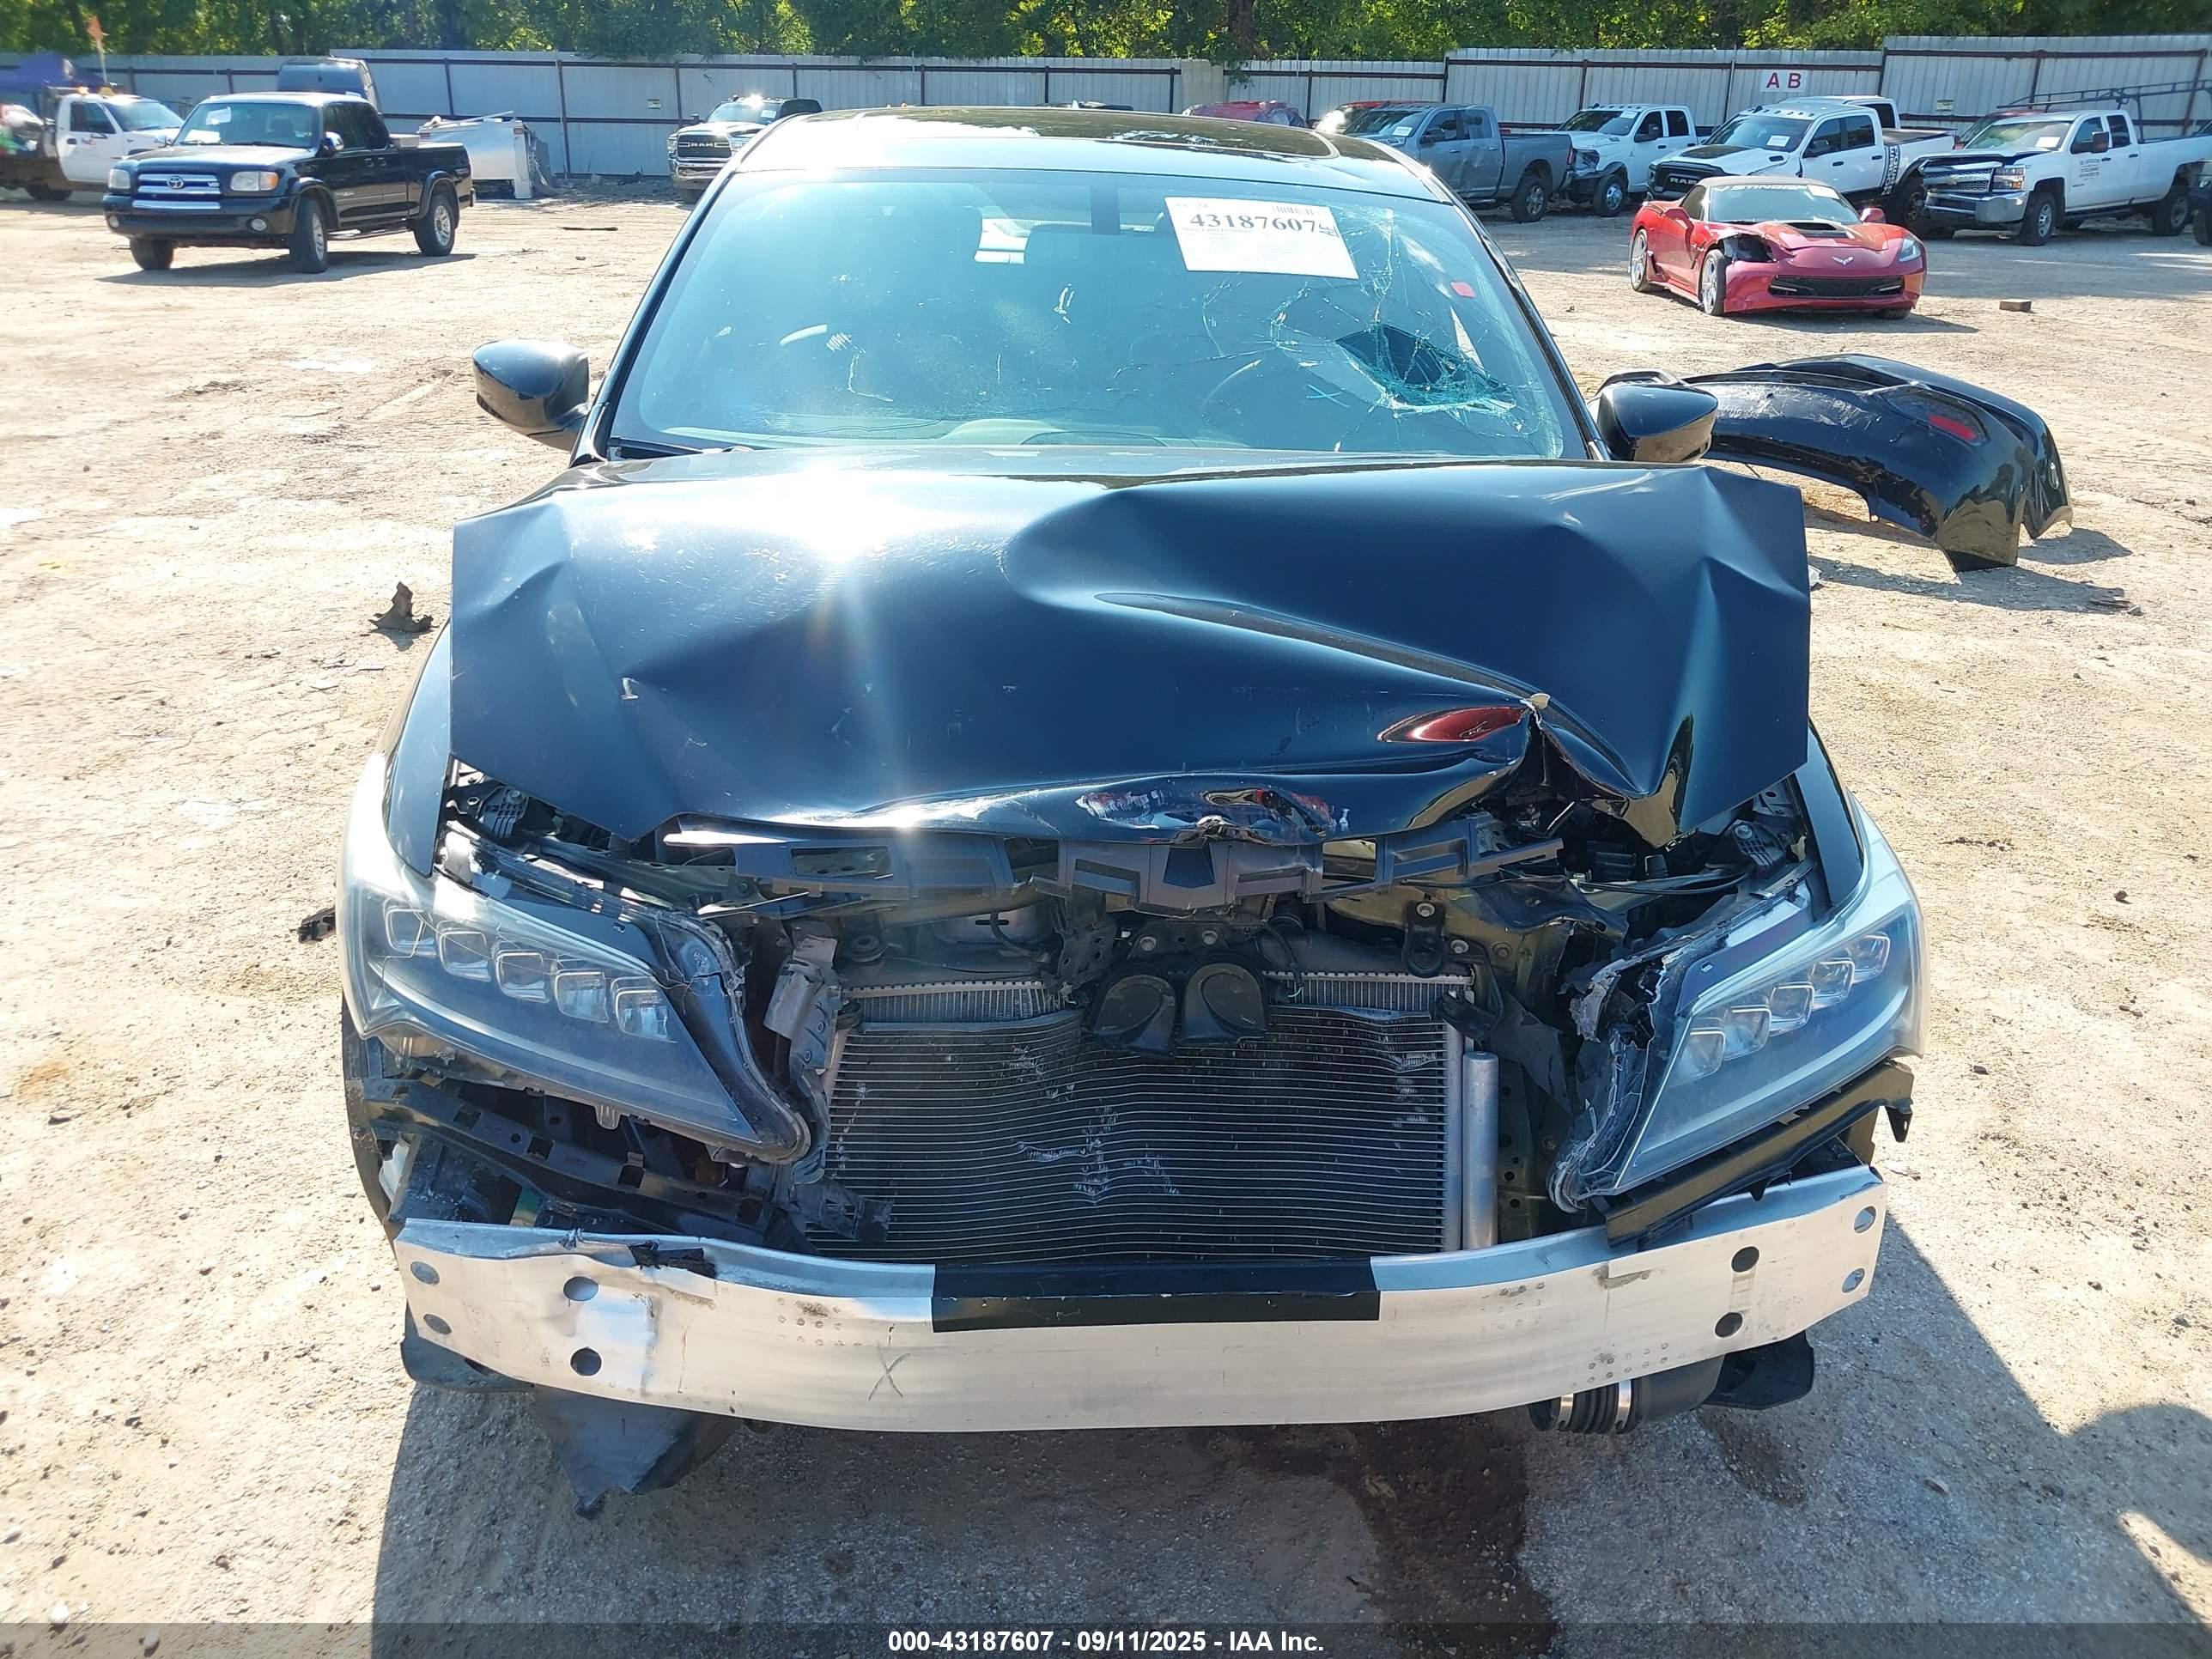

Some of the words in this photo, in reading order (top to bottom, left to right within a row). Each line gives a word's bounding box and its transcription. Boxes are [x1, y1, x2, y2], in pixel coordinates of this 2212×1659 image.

[1766, 72, 1780, 88] A
[1788, 72, 1802, 88] B
[1189, 213, 1316, 233] 43187607
